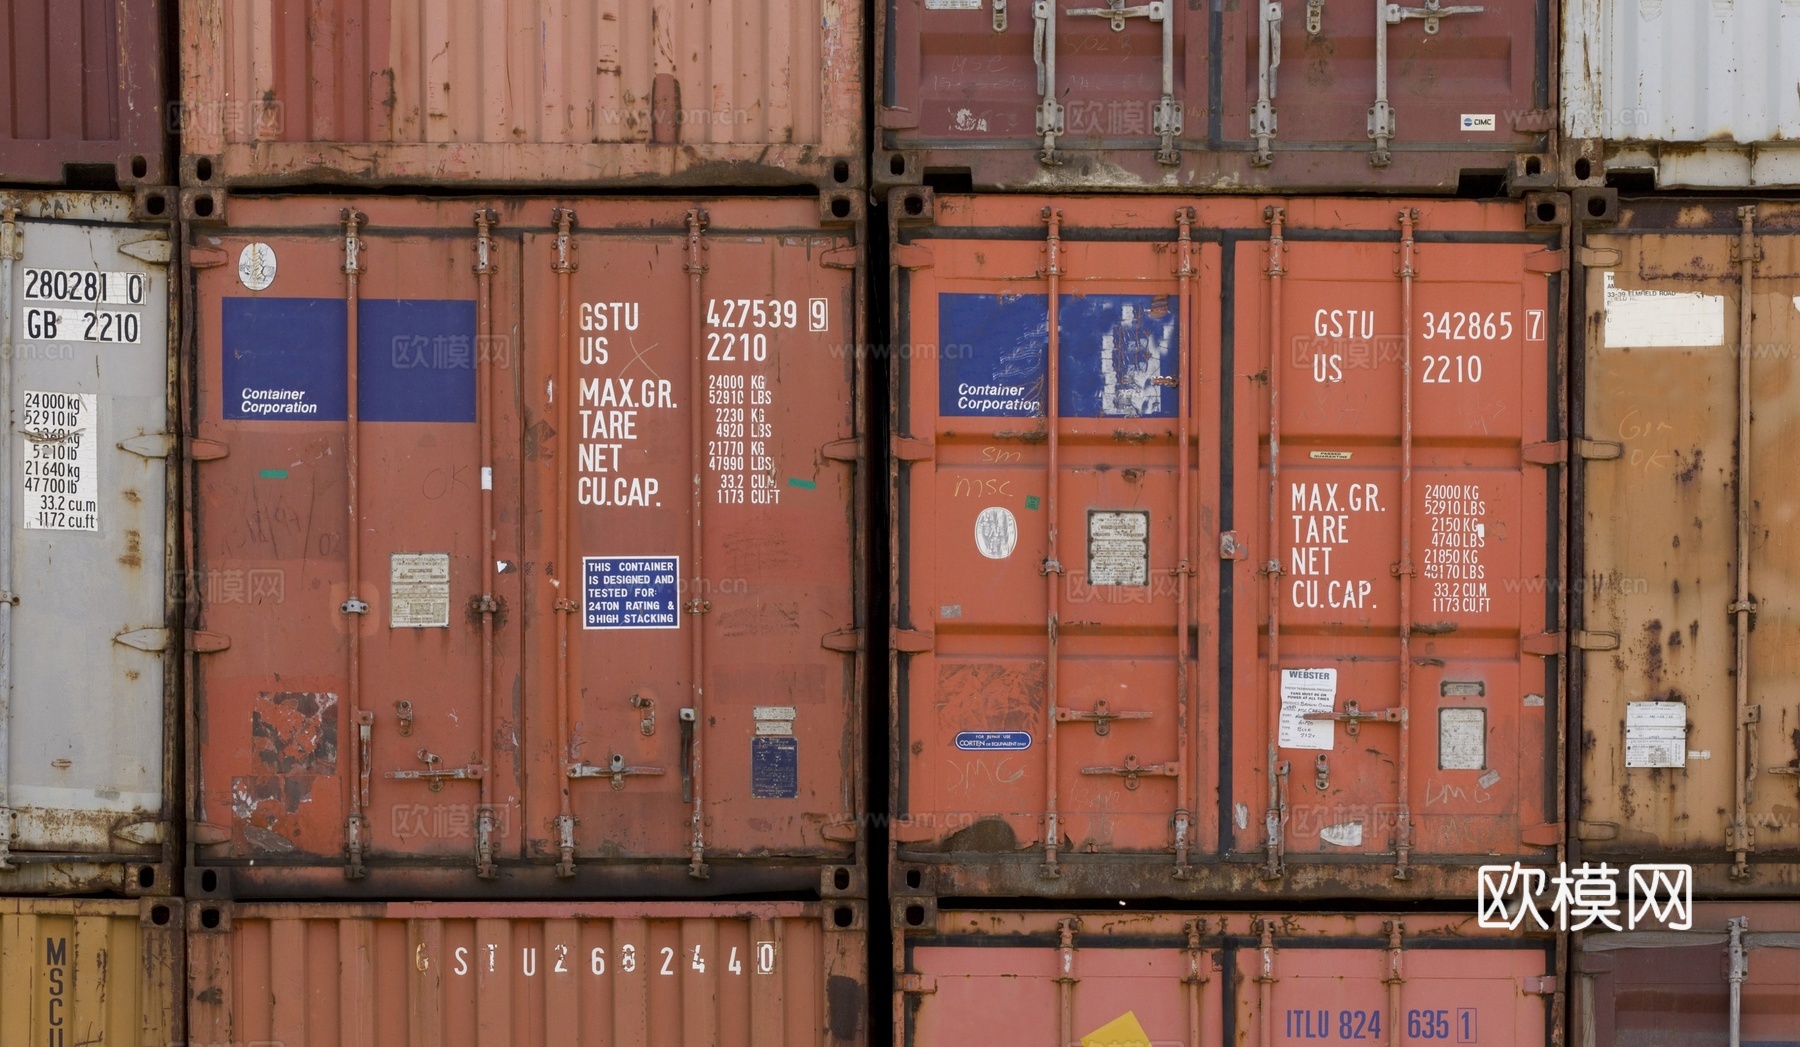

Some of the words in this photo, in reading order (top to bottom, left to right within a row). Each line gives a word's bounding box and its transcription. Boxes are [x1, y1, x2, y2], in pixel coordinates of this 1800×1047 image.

[25, 269, 107, 301] 280281
[129, 275, 142, 303] 0
[579, 302, 639, 331] GSTU
[707, 299, 797, 328] 427539
[811, 300, 826, 329] 9
[28, 309, 57, 339] GB
[84, 312, 138, 342] 2210
[1314, 309, 1374, 339] GSTU
[1422, 311, 1512, 340] 342865
[1528, 311, 1542, 339] 7
[579, 336, 608, 365] US
[707, 333, 767, 362] 2210
[1313, 353, 1343, 382] US
[1422, 355, 1482, 383] 2210
[709, 375, 744, 389] 24000
[751, 375, 765, 389] KG
[958, 383, 1024, 396] Container
[242, 388, 305, 400] Container
[579, 378, 677, 408] MAX.GR.
[751, 390, 772, 404] LBS
[67, 396, 80, 415] kg
[241, 401, 317, 415] Corporation
[958, 397, 1040, 412] Corporation
[67, 413, 77, 427] lb
[716, 408, 744, 422] 2230
[751, 408, 765, 422] KG
[579, 410, 637, 440] TARE
[716, 423, 744, 438] 4920
[751, 423, 772, 438] LBS
[67, 447, 77, 460] lb
[709, 441, 744, 455] 21770
[751, 441, 765, 455] KG
[578, 443, 622, 472] NET
[709, 456, 744, 471] 47990
[751, 456, 772, 471] LBS
[67, 464, 80, 482] kg
[67, 481, 77, 494] lb
[422, 464, 470, 500] OK
[721, 474, 744, 489] 33.2
[578, 477, 661, 507] CU.CAP.
[717, 489, 744, 504] 1173
[1292, 483, 1386, 512] MAX.GR.
[1425, 484, 1461, 500] 24000
[1463, 485, 1479, 500] KG
[40, 495, 65, 511] 33.2
[68, 499, 96, 512] cu.m
[1425, 500, 1461, 515] 52910
[1463, 501, 1485, 515] LBS
[39, 511, 65, 527] 1172
[68, 514, 94, 528] cu.ft
[1431, 517, 1460, 532] 2150
[1463, 517, 1479, 532] KG
[1292, 515, 1348, 544] TARE
[1431, 533, 1460, 548] 4740
[1463, 533, 1485, 548] LBS
[1292, 547, 1332, 575] NET
[1424, 549, 1460, 564] 21850
[1463, 549, 1478, 564] KG
[588, 563, 611, 571] THIS
[619, 562, 673, 571] CONTAINER
[1463, 565, 1485, 579] LBS
[588, 576, 598, 585] IS
[603, 575, 650, 585] DESIGNED
[654, 575, 674, 584] AND
[588, 588, 628, 598] TESTED
[634, 588, 657, 597] FOR:
[1292, 580, 1377, 609] CU.CAP.
[1434, 583, 1459, 597] 33.2
[1463, 583, 1487, 597] CU.M
[626, 601, 660, 610] RATING
[667, 601, 675, 610] &
[1432, 598, 1459, 612] 1173
[1463, 598, 1491, 613] CU.FT
[624, 614, 674, 623] STACKING
[1289, 671, 1330, 680] WEBSTER
[1286, 1010, 1329, 1038] ITLU
[1339, 1010, 1381, 1039] 824
[1407, 1009, 1449, 1038] 635
